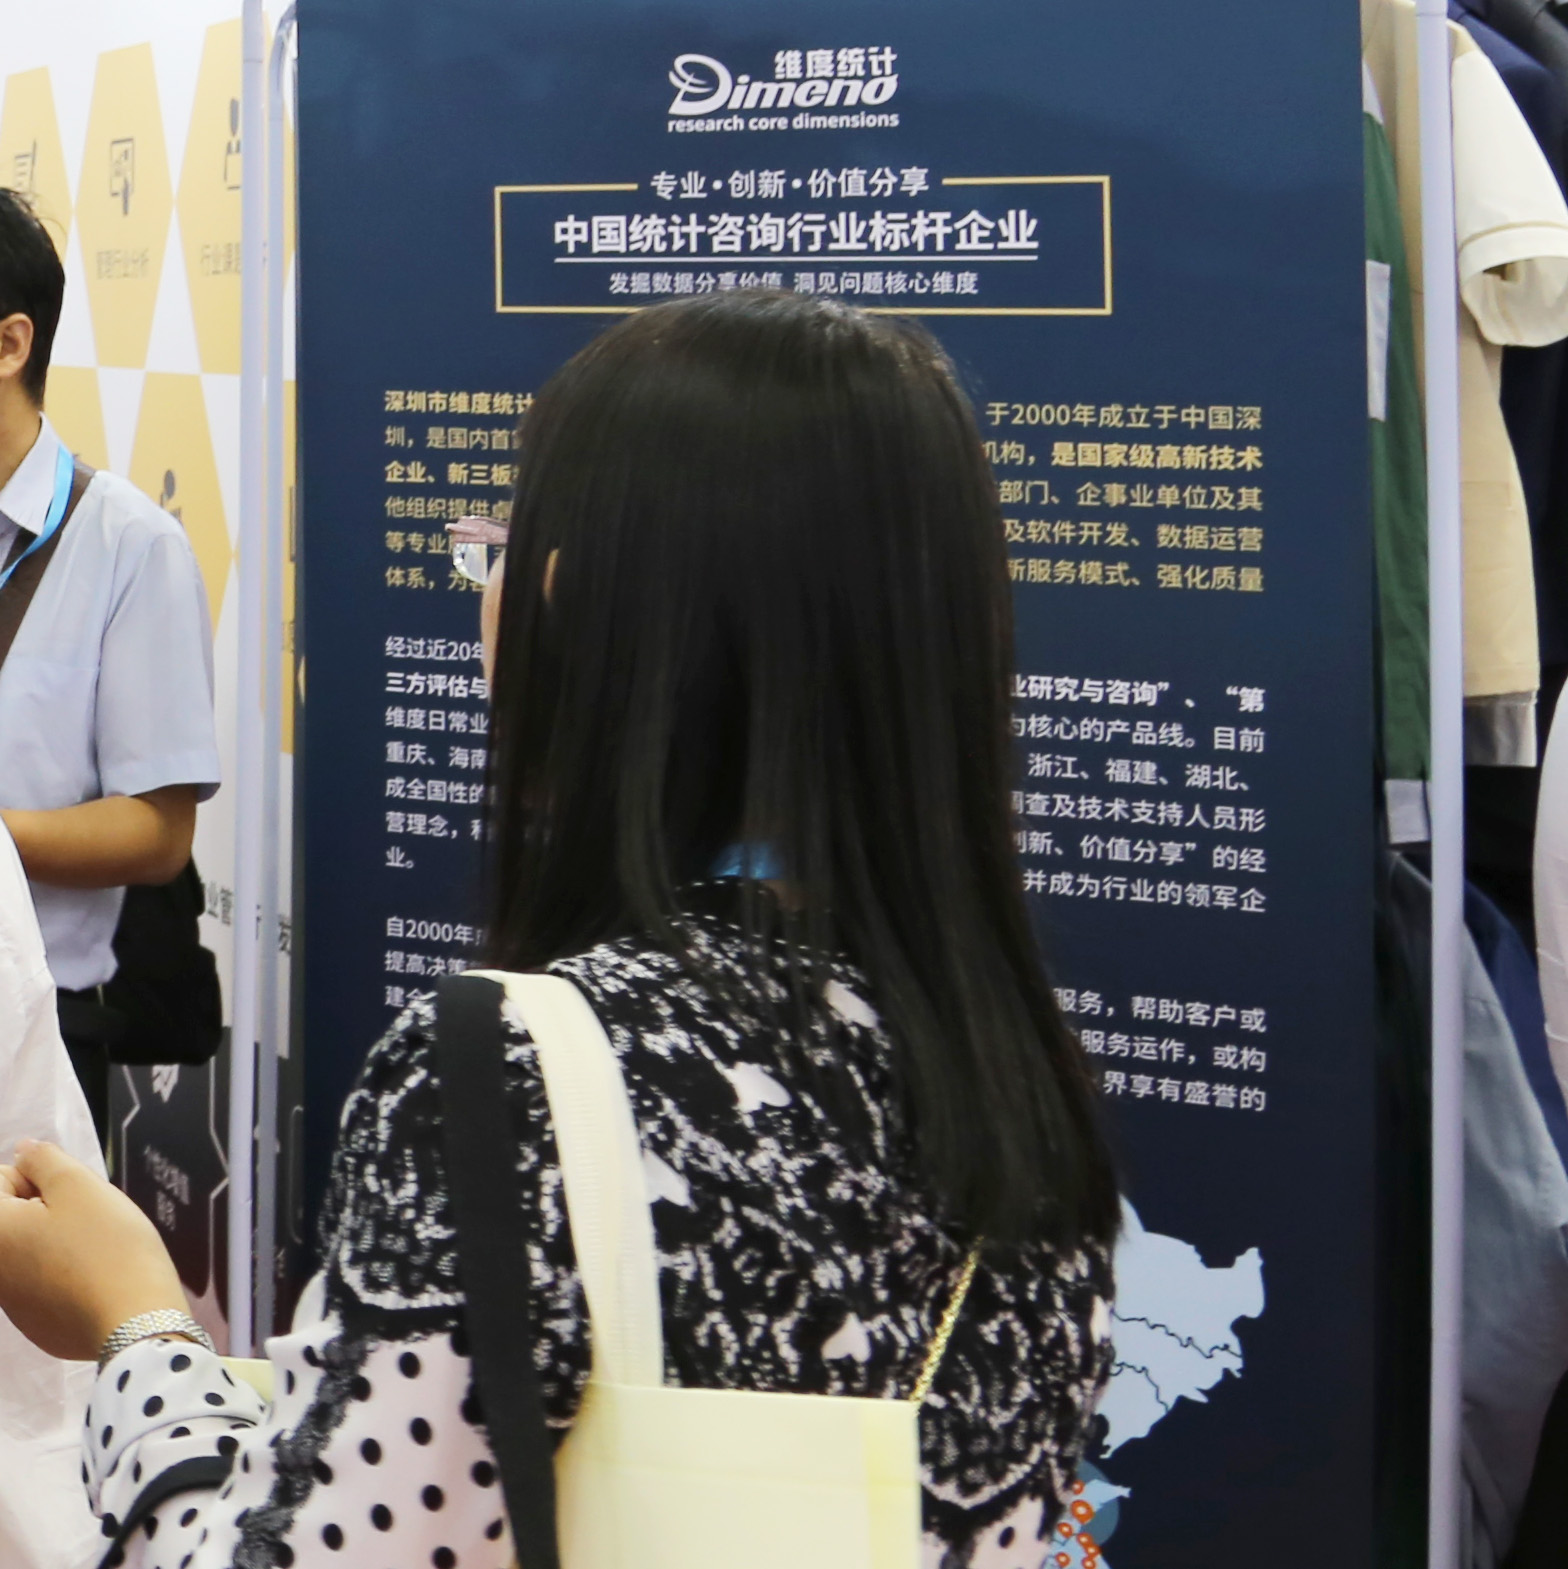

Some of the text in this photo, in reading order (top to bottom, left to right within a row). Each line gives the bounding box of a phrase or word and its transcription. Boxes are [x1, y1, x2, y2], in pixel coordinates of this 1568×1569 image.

[774, 46, 898, 80] 维度统计
[668, 111, 901, 133] research core dimensions
[553, 209, 1040, 254] 中国统计咨询行业标杆企业
[793, 271, 979, 295] 洞见问题核心维度
[384, 390, 535, 415] 深圳市维度统计
[985, 402, 1263, 431] 于2000年成立于中国深
[384, 461, 518, 487] 企业、新三板
[998, 480, 1264, 512] 部门、企事业单位及其
[384, 531, 456, 556] 等专业
[1002, 518, 1264, 552] 及软件开发、数据运营
[384, 671, 490, 700] 三方评估与
[384, 706, 490, 735] 维度日常业
[1028, 752, 1254, 794] 浙江、福建、湖北、
[384, 776, 485, 805] 成全国性的
[384, 845, 416, 869] 业。
[1023, 869, 1267, 913] 并成为行业的领军企
[1068, 1027, 1266, 1074] 服务运作，或构
[1102, 1069, 1266, 1113] 界享有盛誉的
